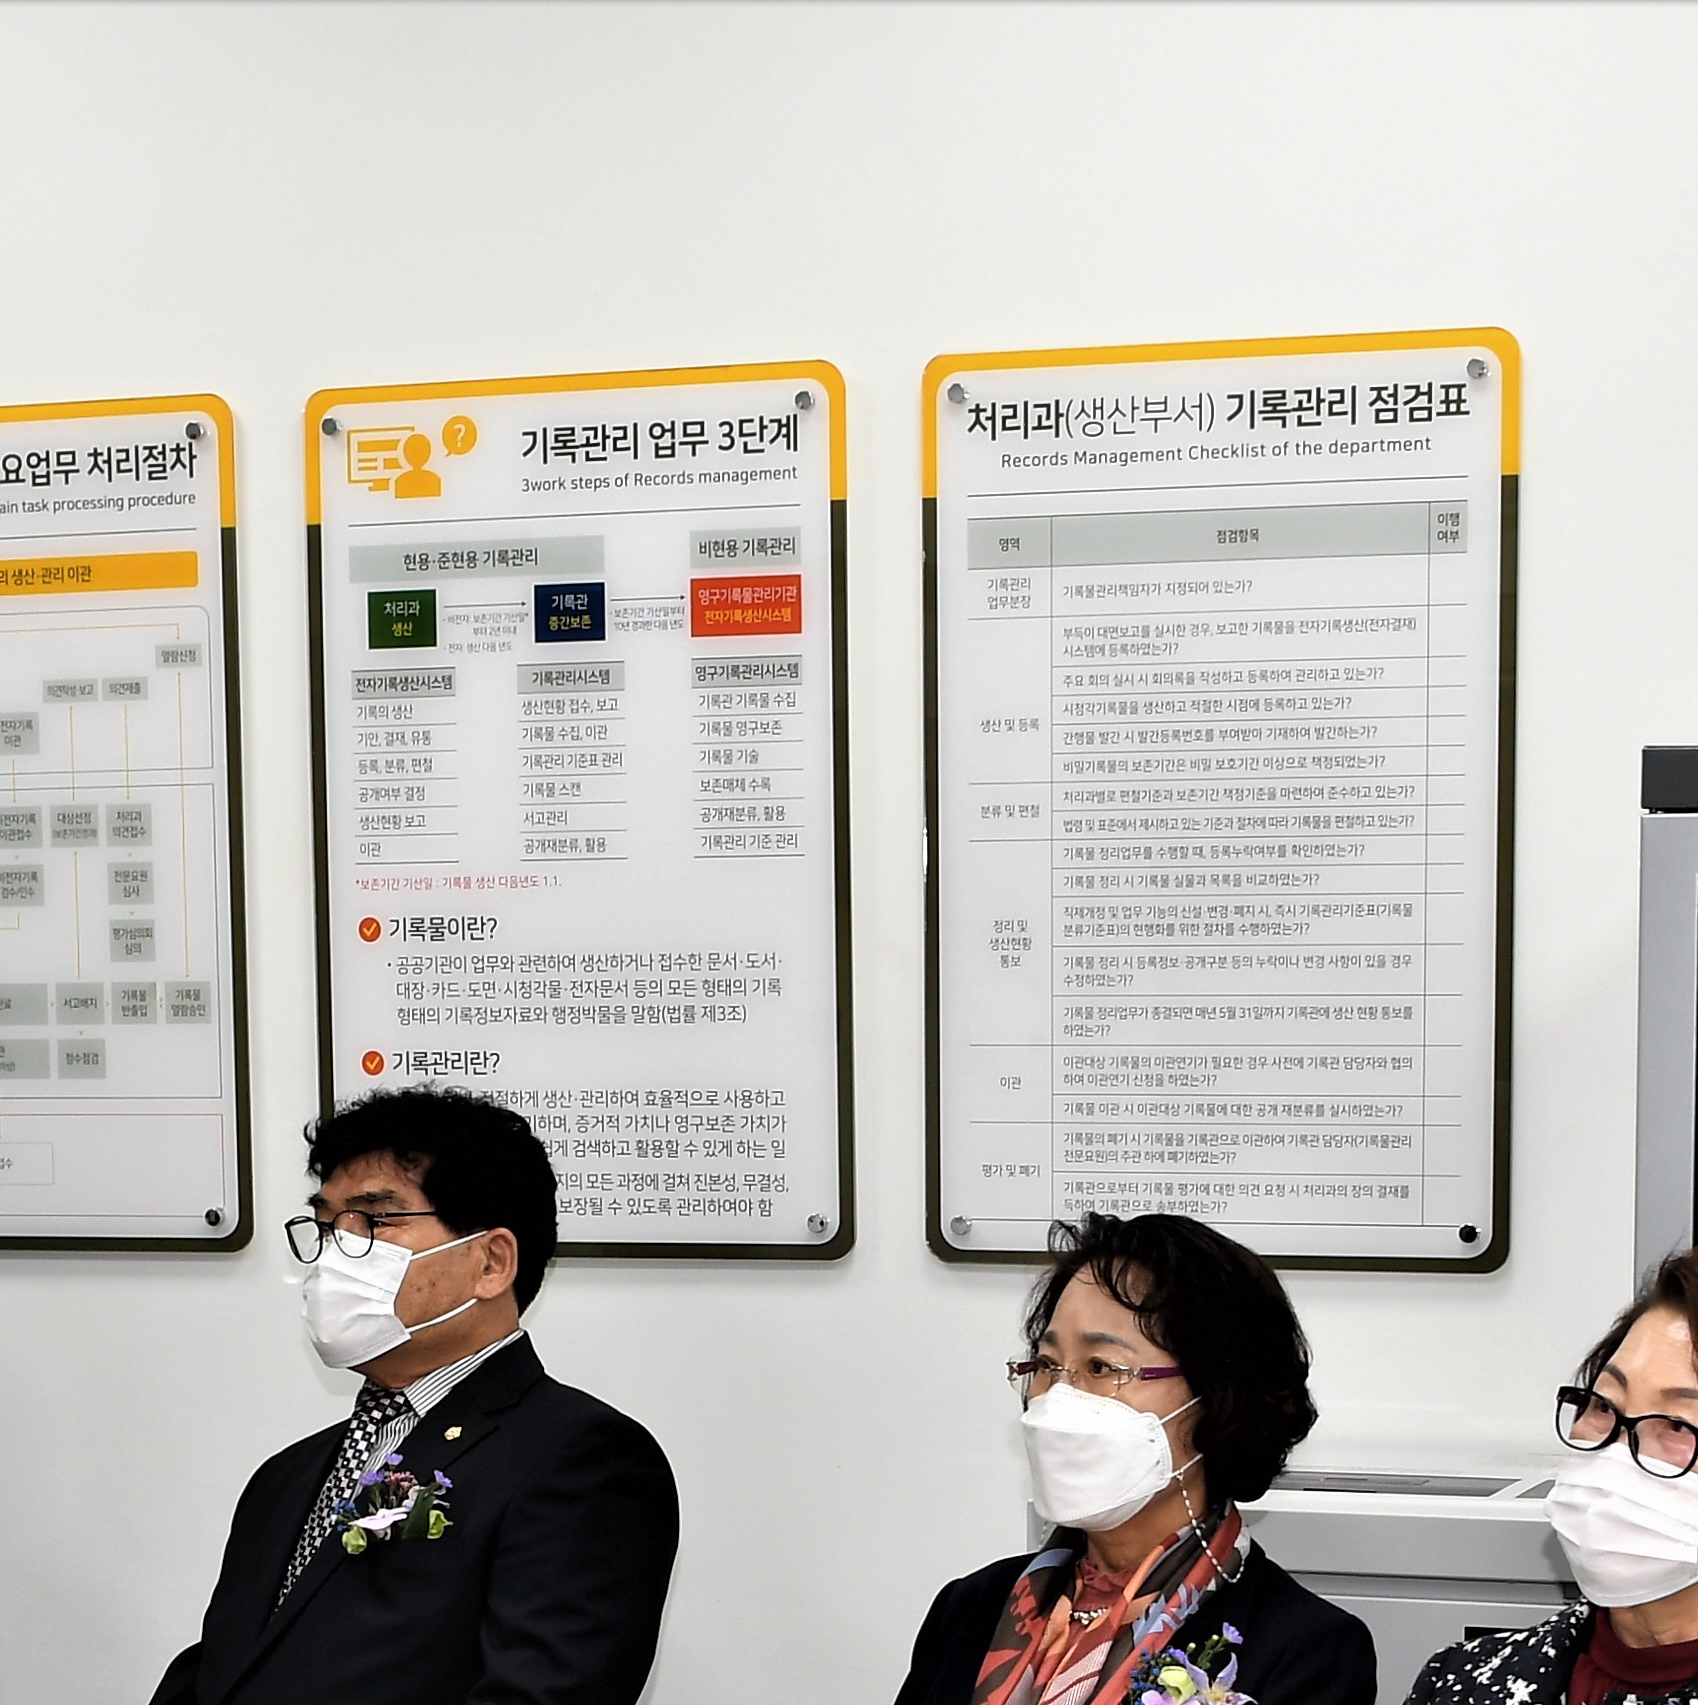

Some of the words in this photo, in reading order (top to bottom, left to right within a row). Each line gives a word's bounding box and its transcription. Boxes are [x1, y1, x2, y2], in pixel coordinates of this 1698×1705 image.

[966, 391, 1217, 441] 처리과(생산부서)
[1226, 386, 1356, 428] 기록관리
[1368, 383, 1470, 423] 점검표
[521, 423, 638, 463] 기록관리
[648, 420, 709, 458] 업무
[717, 414, 798, 453] 3단계
[86, 441, 198, 481] 처리절차
[1001, 451, 1068, 467] Records
[1073, 448, 1182, 466] Management
[1188, 443, 1266, 459] Checklist
[1271, 440, 1289, 456] of
[1295, 440, 1322, 455] the
[1328, 437, 1431, 456] department
[521, 476, 566, 492] 3work
[570, 476, 610, 491] steps
[614, 472, 629, 487] of
[634, 470, 694, 486] Records
[698, 467, 797, 485] management
[20, 498, 49, 514] task
[51, 495, 125, 513] processing
[126, 492, 197, 510] procedure
[697, 539, 739, 558] 비현용
[742, 537, 796, 556] 기록관리
[402, 550, 479, 571] 현용·준현용
[482, 547, 539, 567] 기록관리
[10, 566, 66, 586] 생산·관리
[67, 565, 92, 582] 이관
[383, 600, 420, 616] 처리과
[551, 593, 588, 610] 기록관
[391, 621, 413, 636] 생산
[548, 614, 592, 630] 중간보존
[532, 669, 611, 686] 기록관리시스템
[694, 662, 800, 681] 영구기록관리시스템
[389, 916, 497, 941] 기록물이란?
[395, 954, 468, 975] 공공기관이
[469, 954, 515, 974] 업무와
[517, 954, 577, 974] 관련하여
[579, 953, 654, 972] 생산하거나
[657, 952, 702, 971] 접수한
[397, 1006, 441, 1025] 형태의
[445, 1005, 548, 1024] 기록정보자료와
[551, 1005, 627, 1024] 행정박물을
[629, 1004, 697, 1025] 말함(법률
[700, 1004, 748, 1022] 제3조)
[392, 1051, 500, 1075] 기록관리란?
[542, 1089, 640, 1108] 생산·관리하여
[643, 1089, 720, 1108] 효율적으로
[723, 1089, 786, 1108] 사용하고
[585, 1172, 614, 1191] 모든
[616, 1172, 659, 1191] 과정에
[662, 1172, 691, 1191] 걸쳐
[693, 1172, 740, 1193] 진본성,
[742, 1172, 789, 1192] 무결성,
